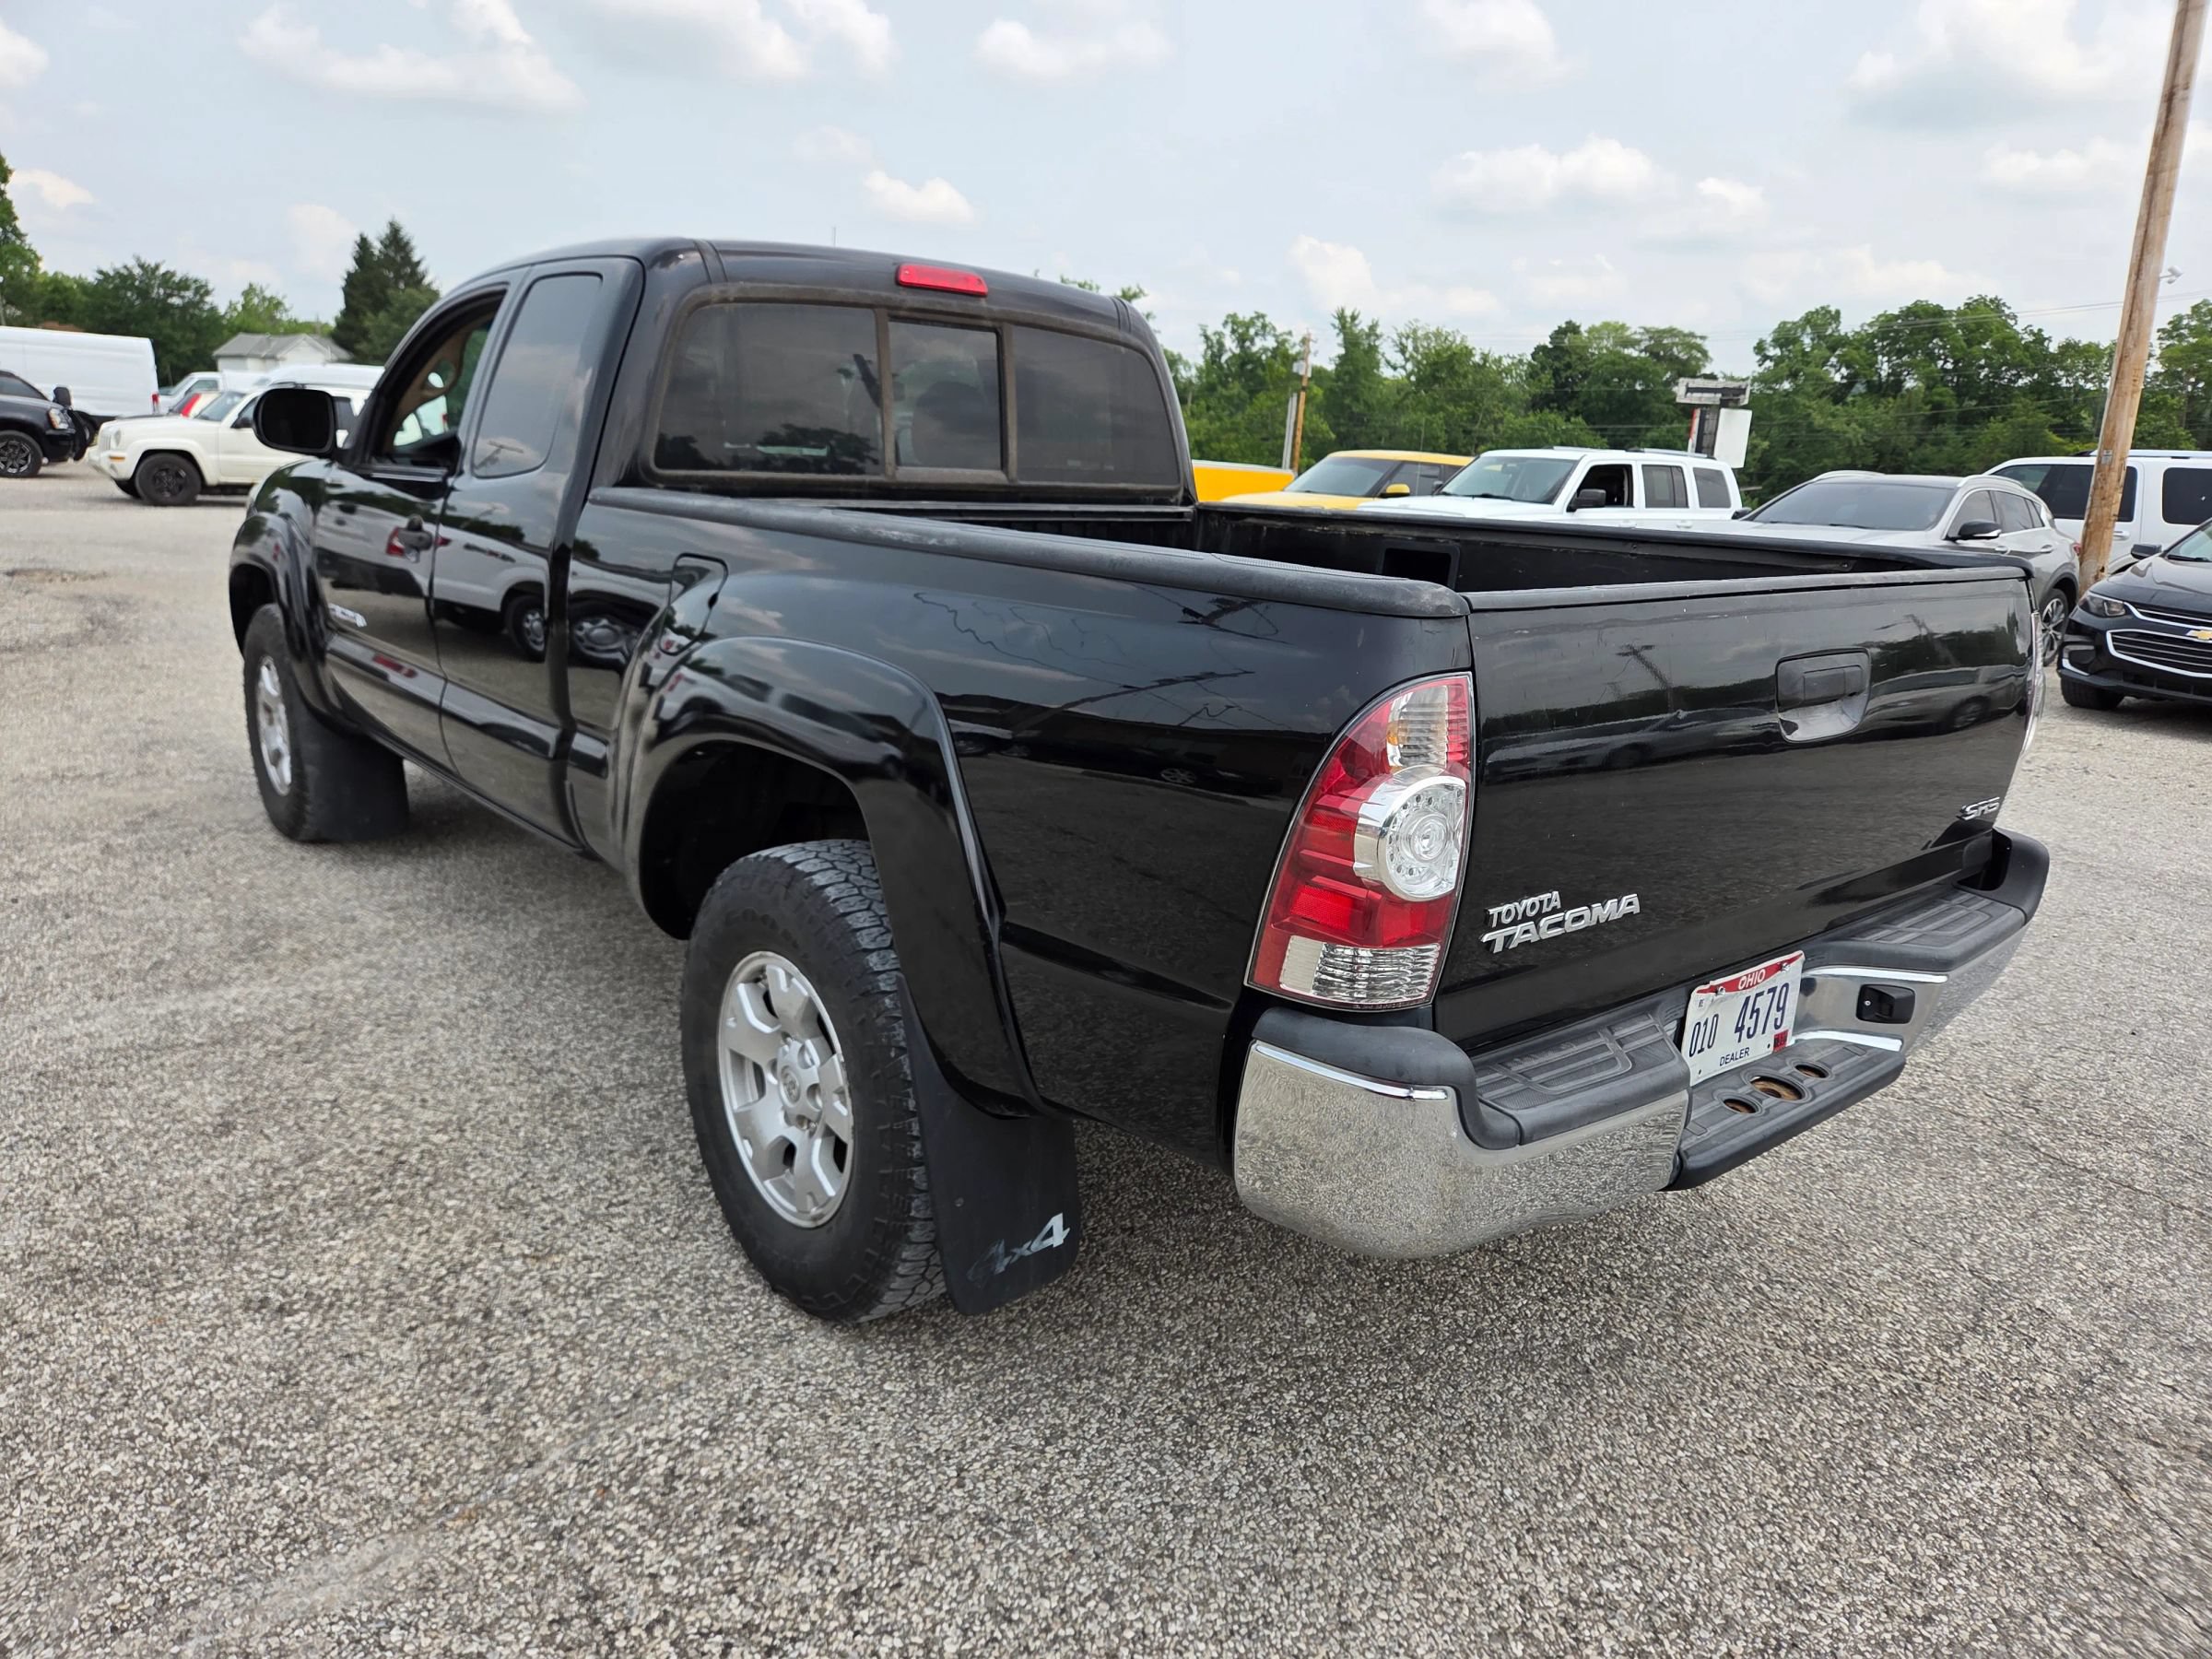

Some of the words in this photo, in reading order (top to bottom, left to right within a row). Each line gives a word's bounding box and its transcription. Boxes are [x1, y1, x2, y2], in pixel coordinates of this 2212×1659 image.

[1960, 796, 2000, 820] SR5
[1480, 893, 1641, 953] TACOMA
[1487, 890, 1561, 928] TOYOTA
[1737, 969, 1766, 991] OHIO
[1688, 1014, 1719, 1057] 010
[1735, 982, 1789, 1043] 4579
[1720, 1047, 1749, 1066] DEALER
